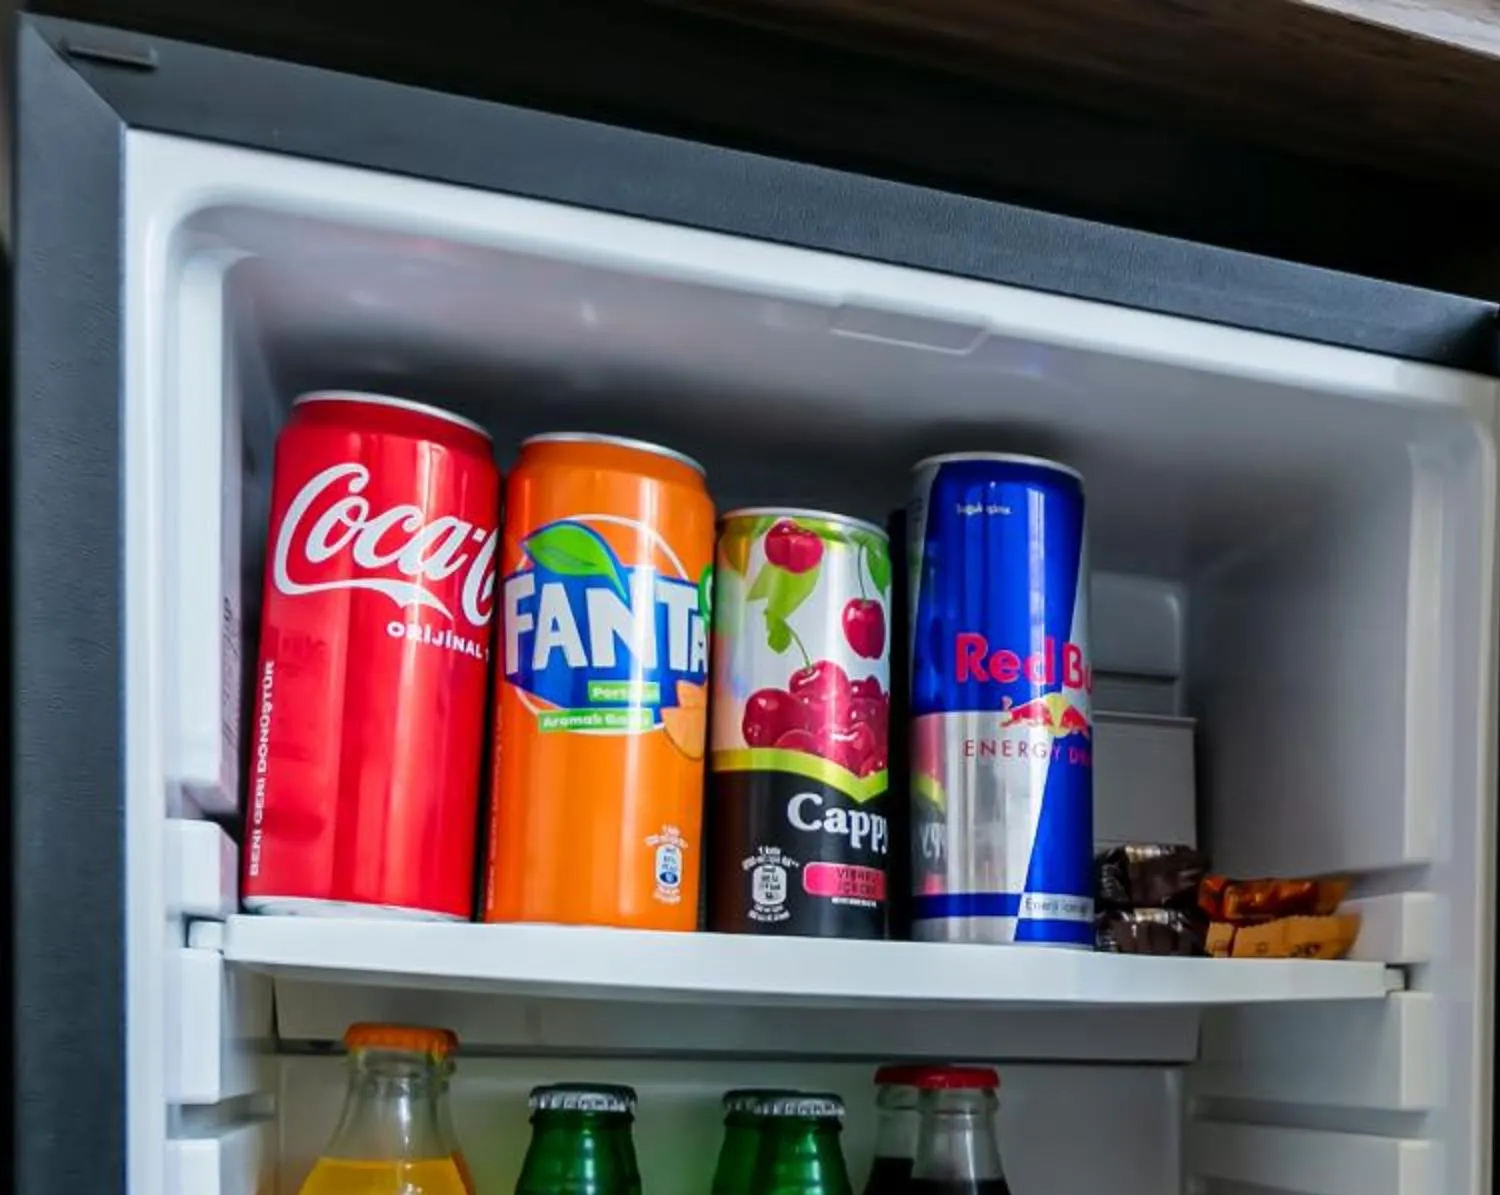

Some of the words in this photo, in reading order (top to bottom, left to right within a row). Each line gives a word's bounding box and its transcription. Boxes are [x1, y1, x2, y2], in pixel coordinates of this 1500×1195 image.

[505, 567, 708, 675] FANTA
[956, 633, 1055, 684] Red
[965, 739, 1061, 761] ENERGY
